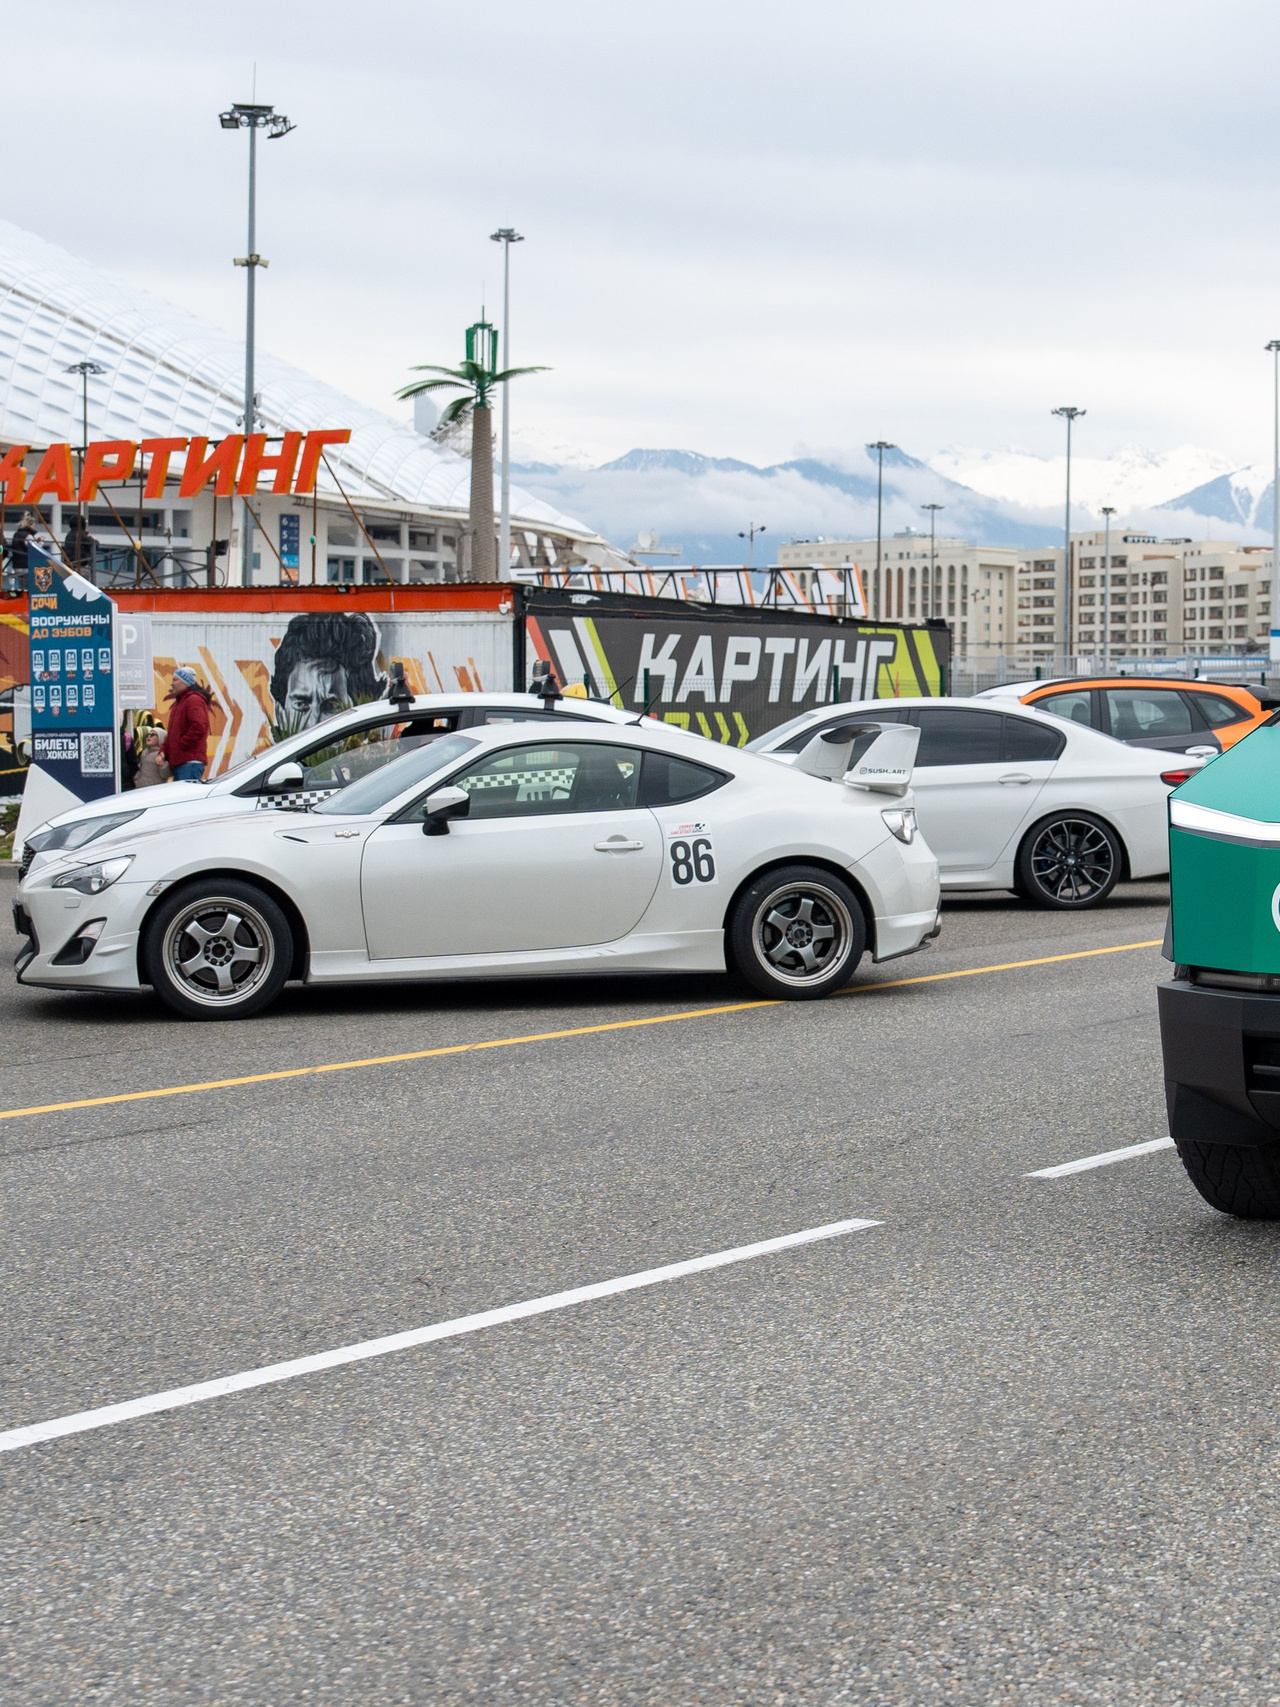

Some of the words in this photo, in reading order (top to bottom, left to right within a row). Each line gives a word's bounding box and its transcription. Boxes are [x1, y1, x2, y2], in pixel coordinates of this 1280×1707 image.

[282, 517, 289, 526] 6
[31, 597, 58, 611] СОЧИ
[31, 614, 110, 627] ВООРУЖЕНЫ
[32, 628, 49, 640] ДО
[52, 626, 92, 637] ЗУБОВ
[633, 632, 894, 703] КАРТИНГ
[35, 739, 78, 750] БИЛЕТЫ
[47, 750, 78, 759] ХОККЕЙ
[670, 838, 716, 885] 86
